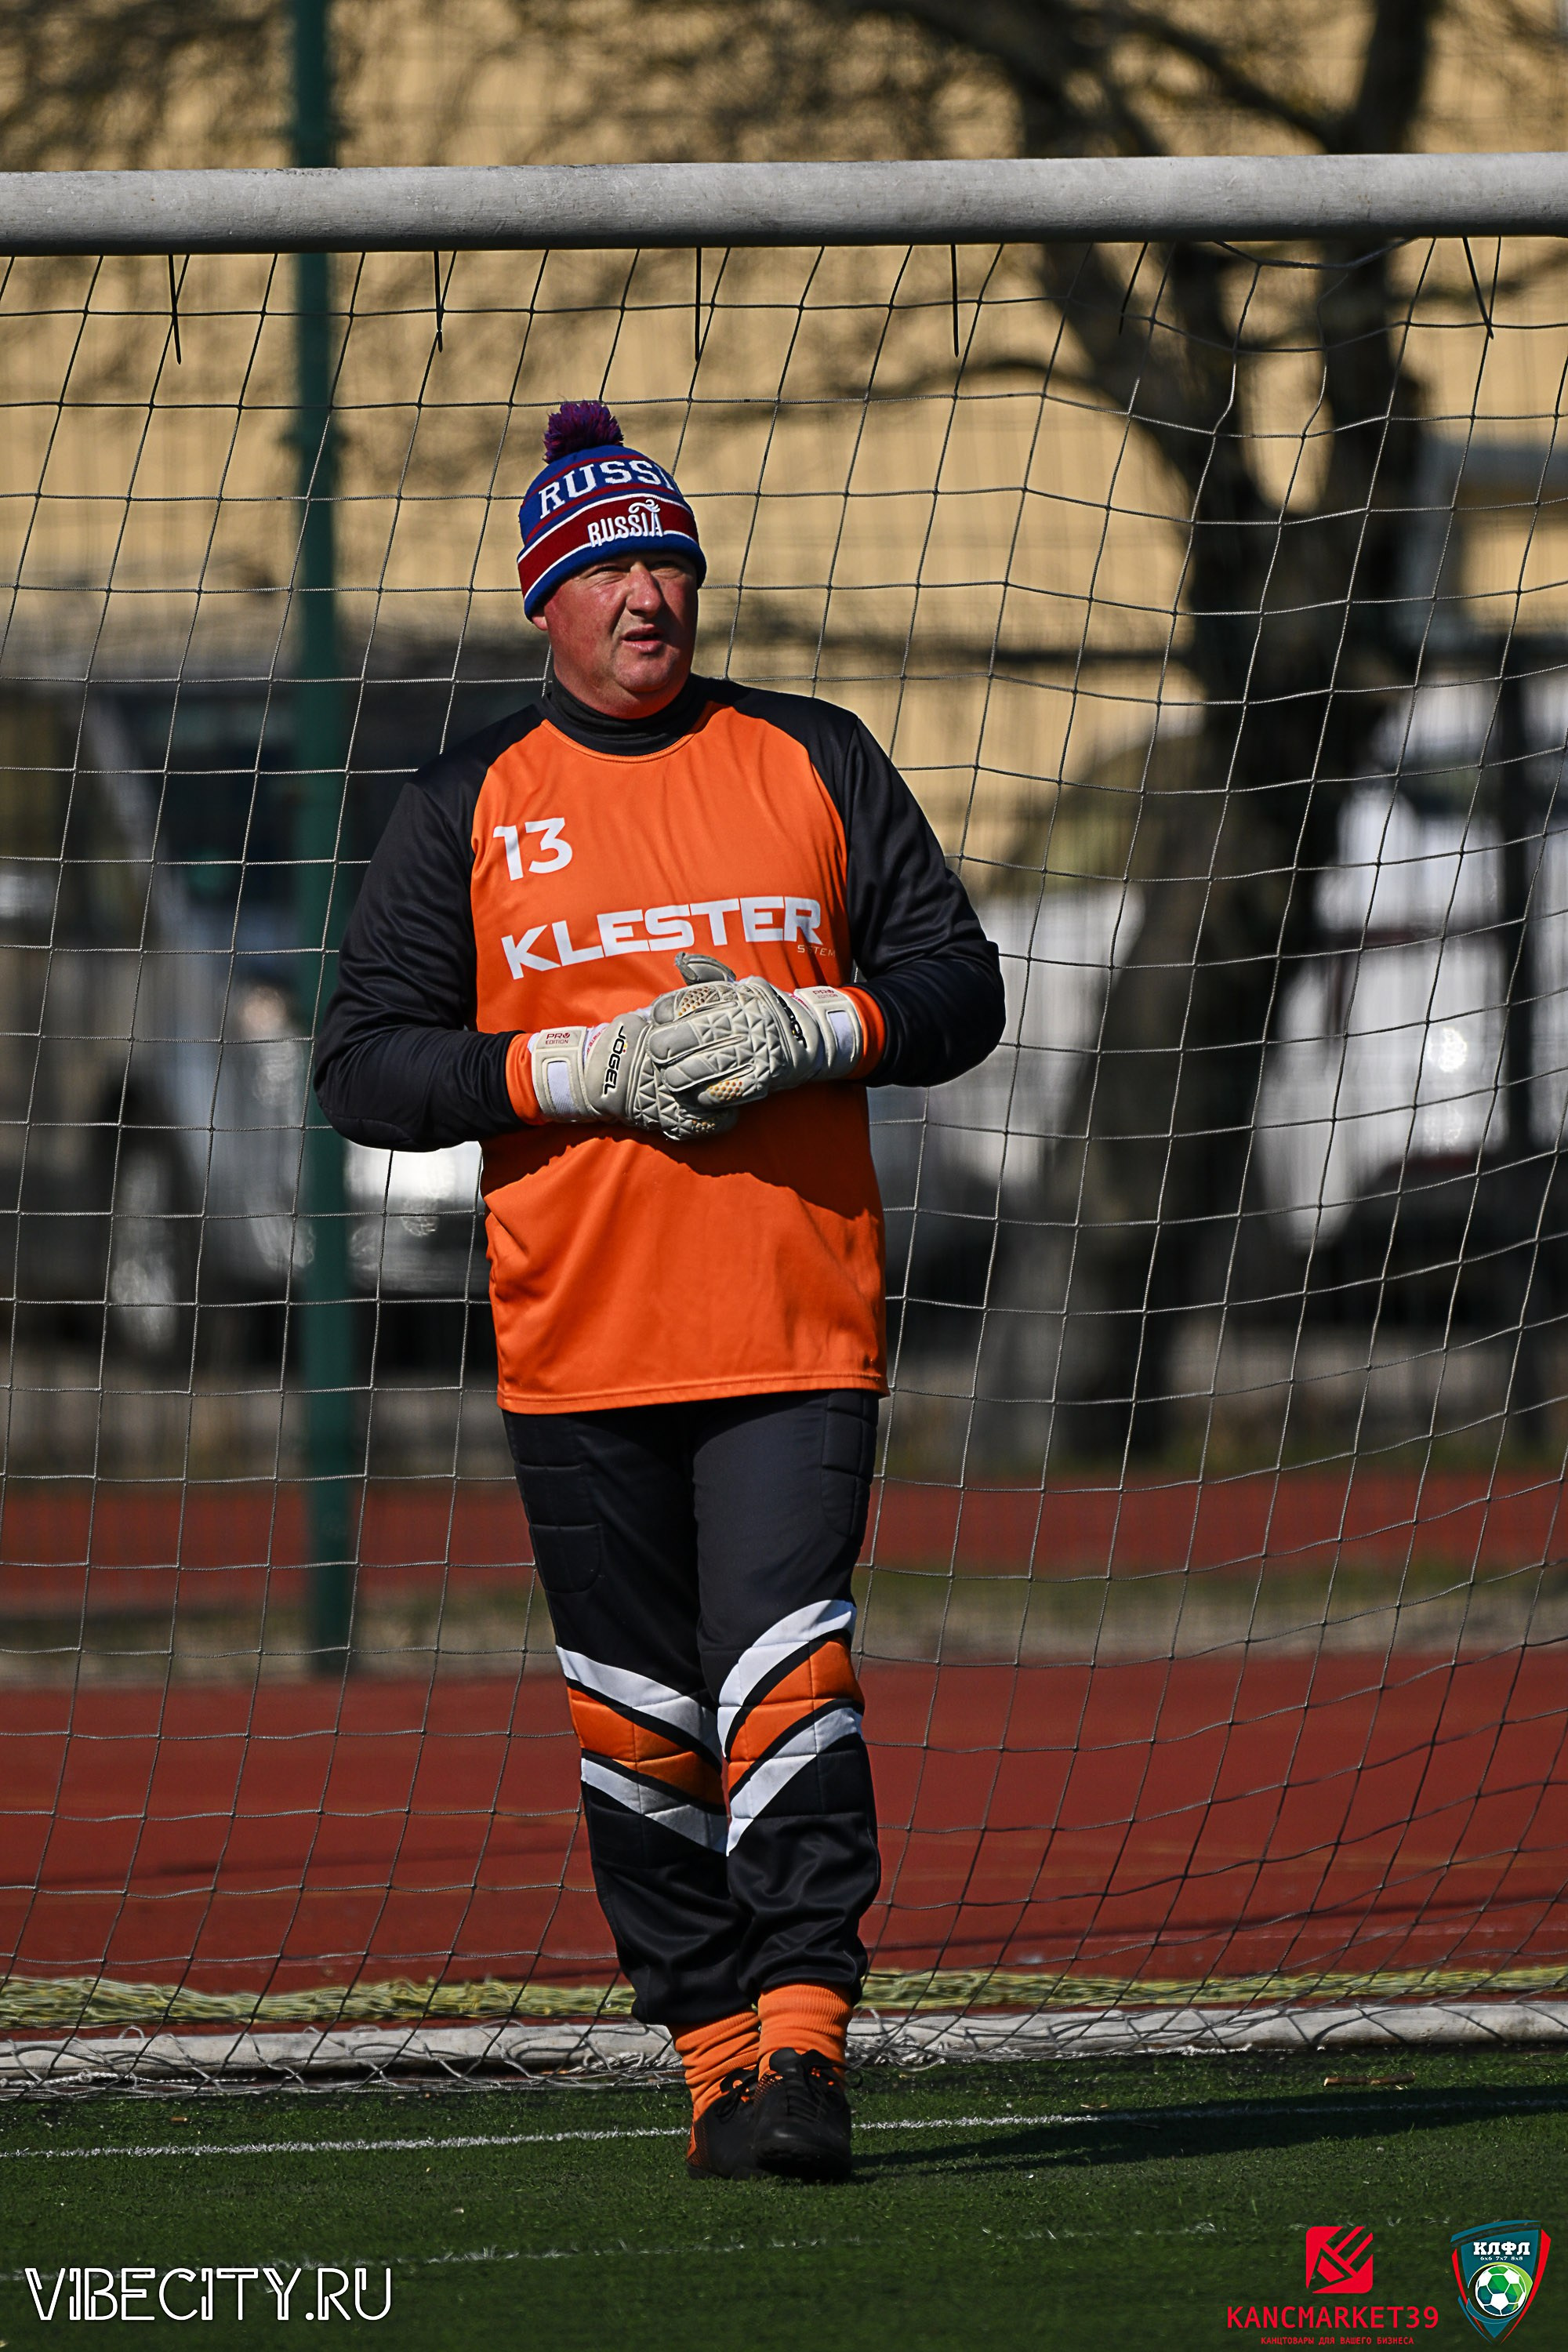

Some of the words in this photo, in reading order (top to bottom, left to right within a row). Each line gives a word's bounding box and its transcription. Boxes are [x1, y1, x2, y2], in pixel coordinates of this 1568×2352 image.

[587, 500, 663, 547] RUSSIA
[493, 818, 572, 881] 13
[502, 896, 822, 980] KLESTER
[797, 945, 836, 957] STEM
